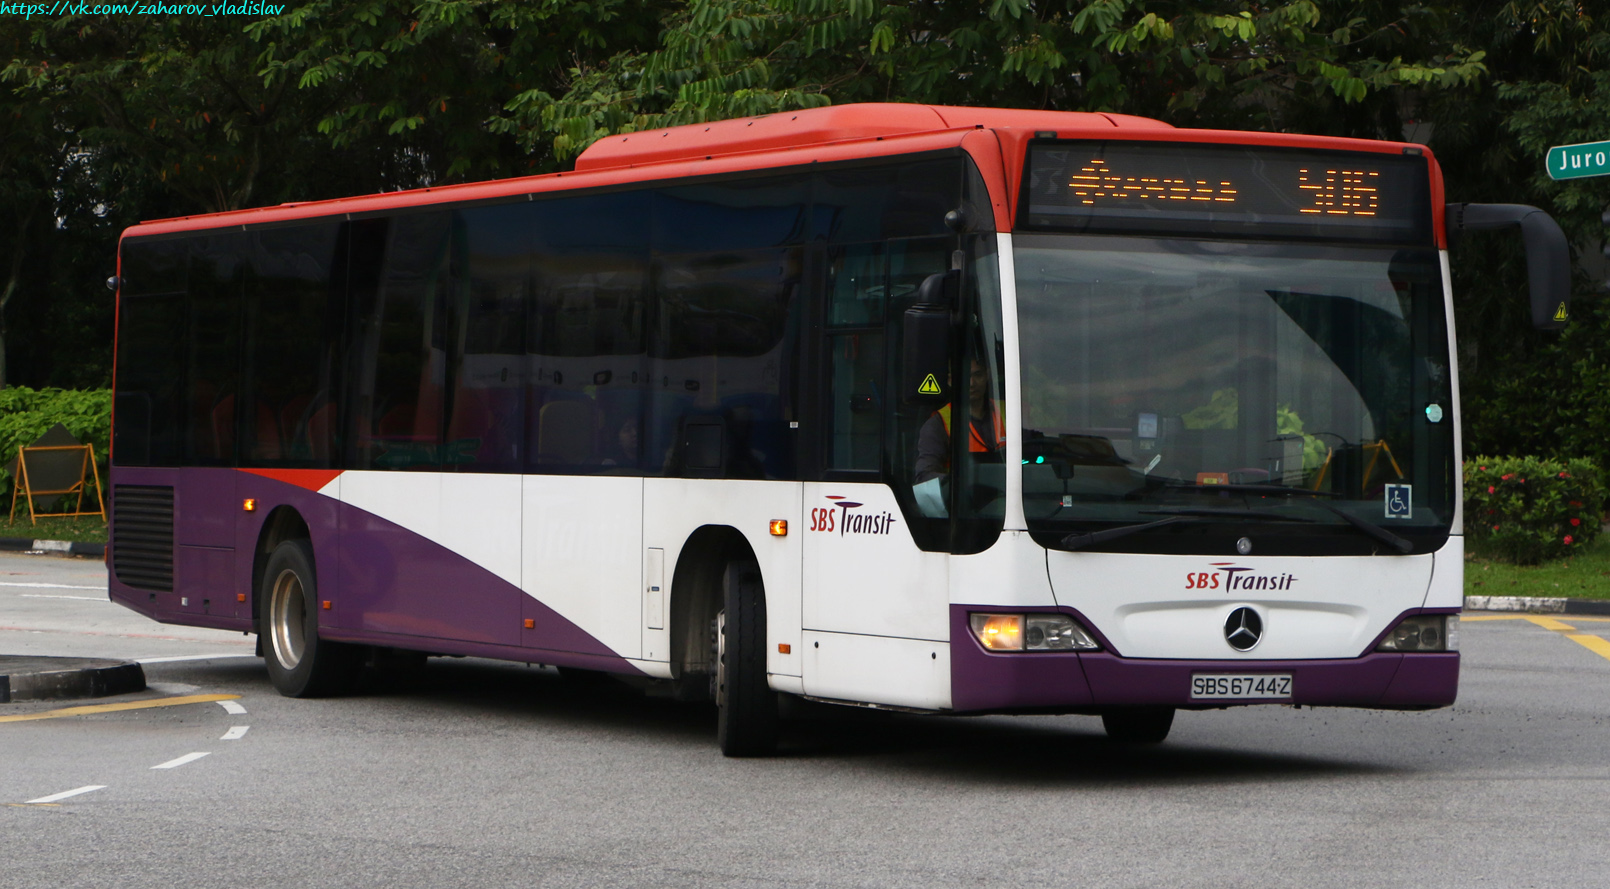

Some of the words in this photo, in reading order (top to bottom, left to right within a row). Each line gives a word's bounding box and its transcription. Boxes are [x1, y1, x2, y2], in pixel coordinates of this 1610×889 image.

[1559, 150, 1610, 170] Juro
[810, 507, 836, 533] SBS
[834, 501, 897, 538] Transit
[1185, 572, 1220, 590] SBS
[1216, 567, 1299, 594] Transit
